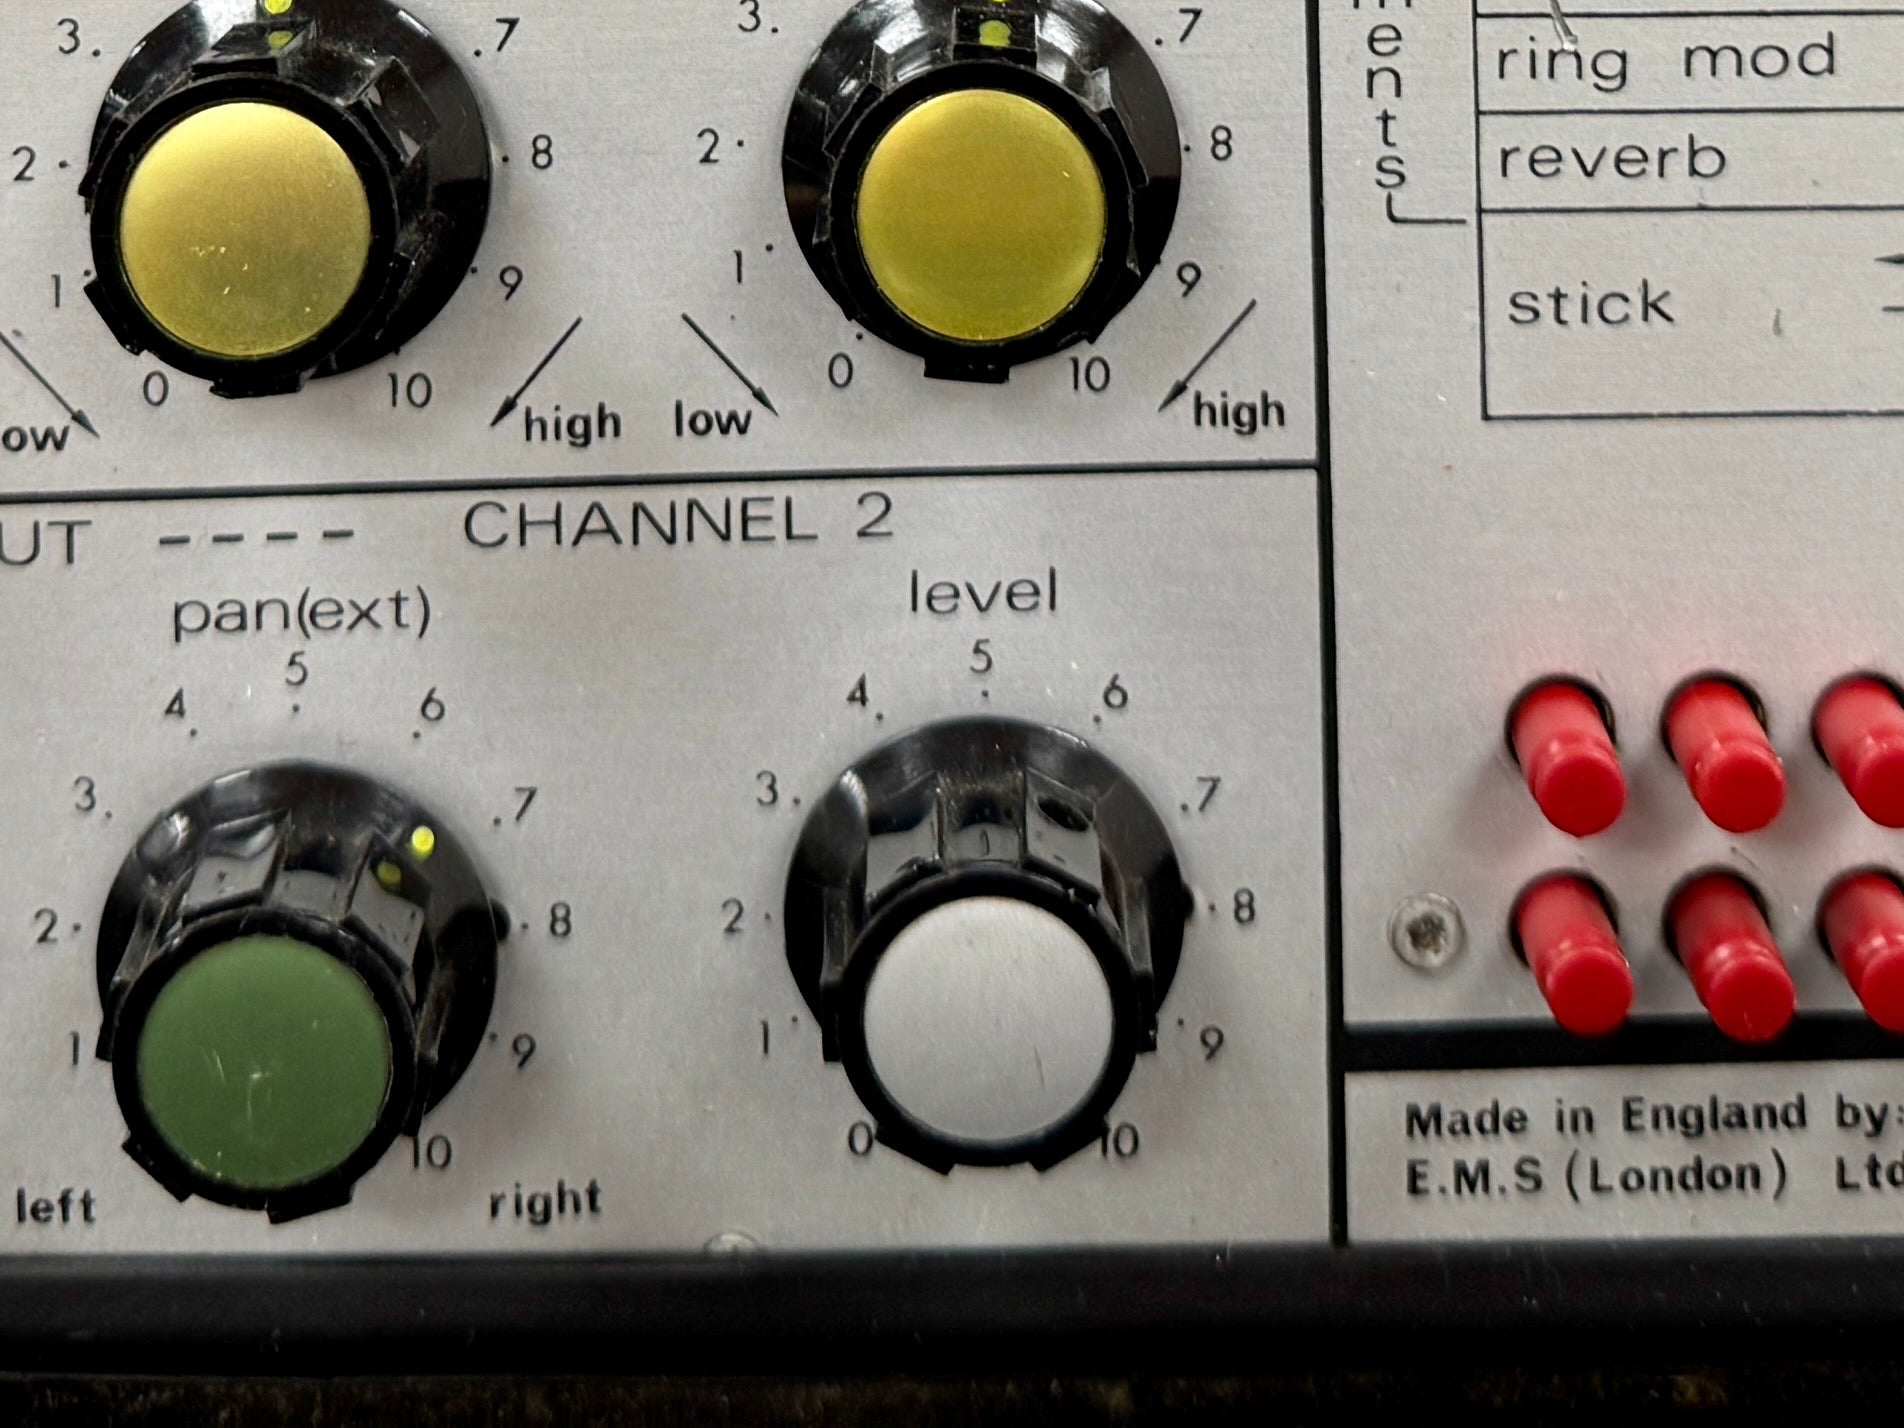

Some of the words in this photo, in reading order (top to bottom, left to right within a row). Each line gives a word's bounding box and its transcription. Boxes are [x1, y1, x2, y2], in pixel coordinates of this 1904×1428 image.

[57, 18, 80, 55] 3
[1499, 38, 1628, 94] ring
[1684, 31, 1835, 79] mod
[1501, 133, 1726, 179] reverb
[1509, 278, 1674, 327] stick
[524, 402, 622, 450] high
[675, 400, 752, 438] low
[1192, 391, 1286, 436] high
[464, 496, 818, 549] CHANNEL
[857, 491, 893, 539] 2
[174, 585, 430, 645] pan(ext)
[911, 566, 1056, 616] level
[846, 673, 869, 708] 4
[1406, 1099, 1528, 1141] Made
[1556, 1107, 1595, 1138] in
[1623, 1093, 1807, 1141] England
[1566, 1148, 1787, 1204] (London)
[17, 1188, 95, 1226] left
[490, 1179, 600, 1228] right
